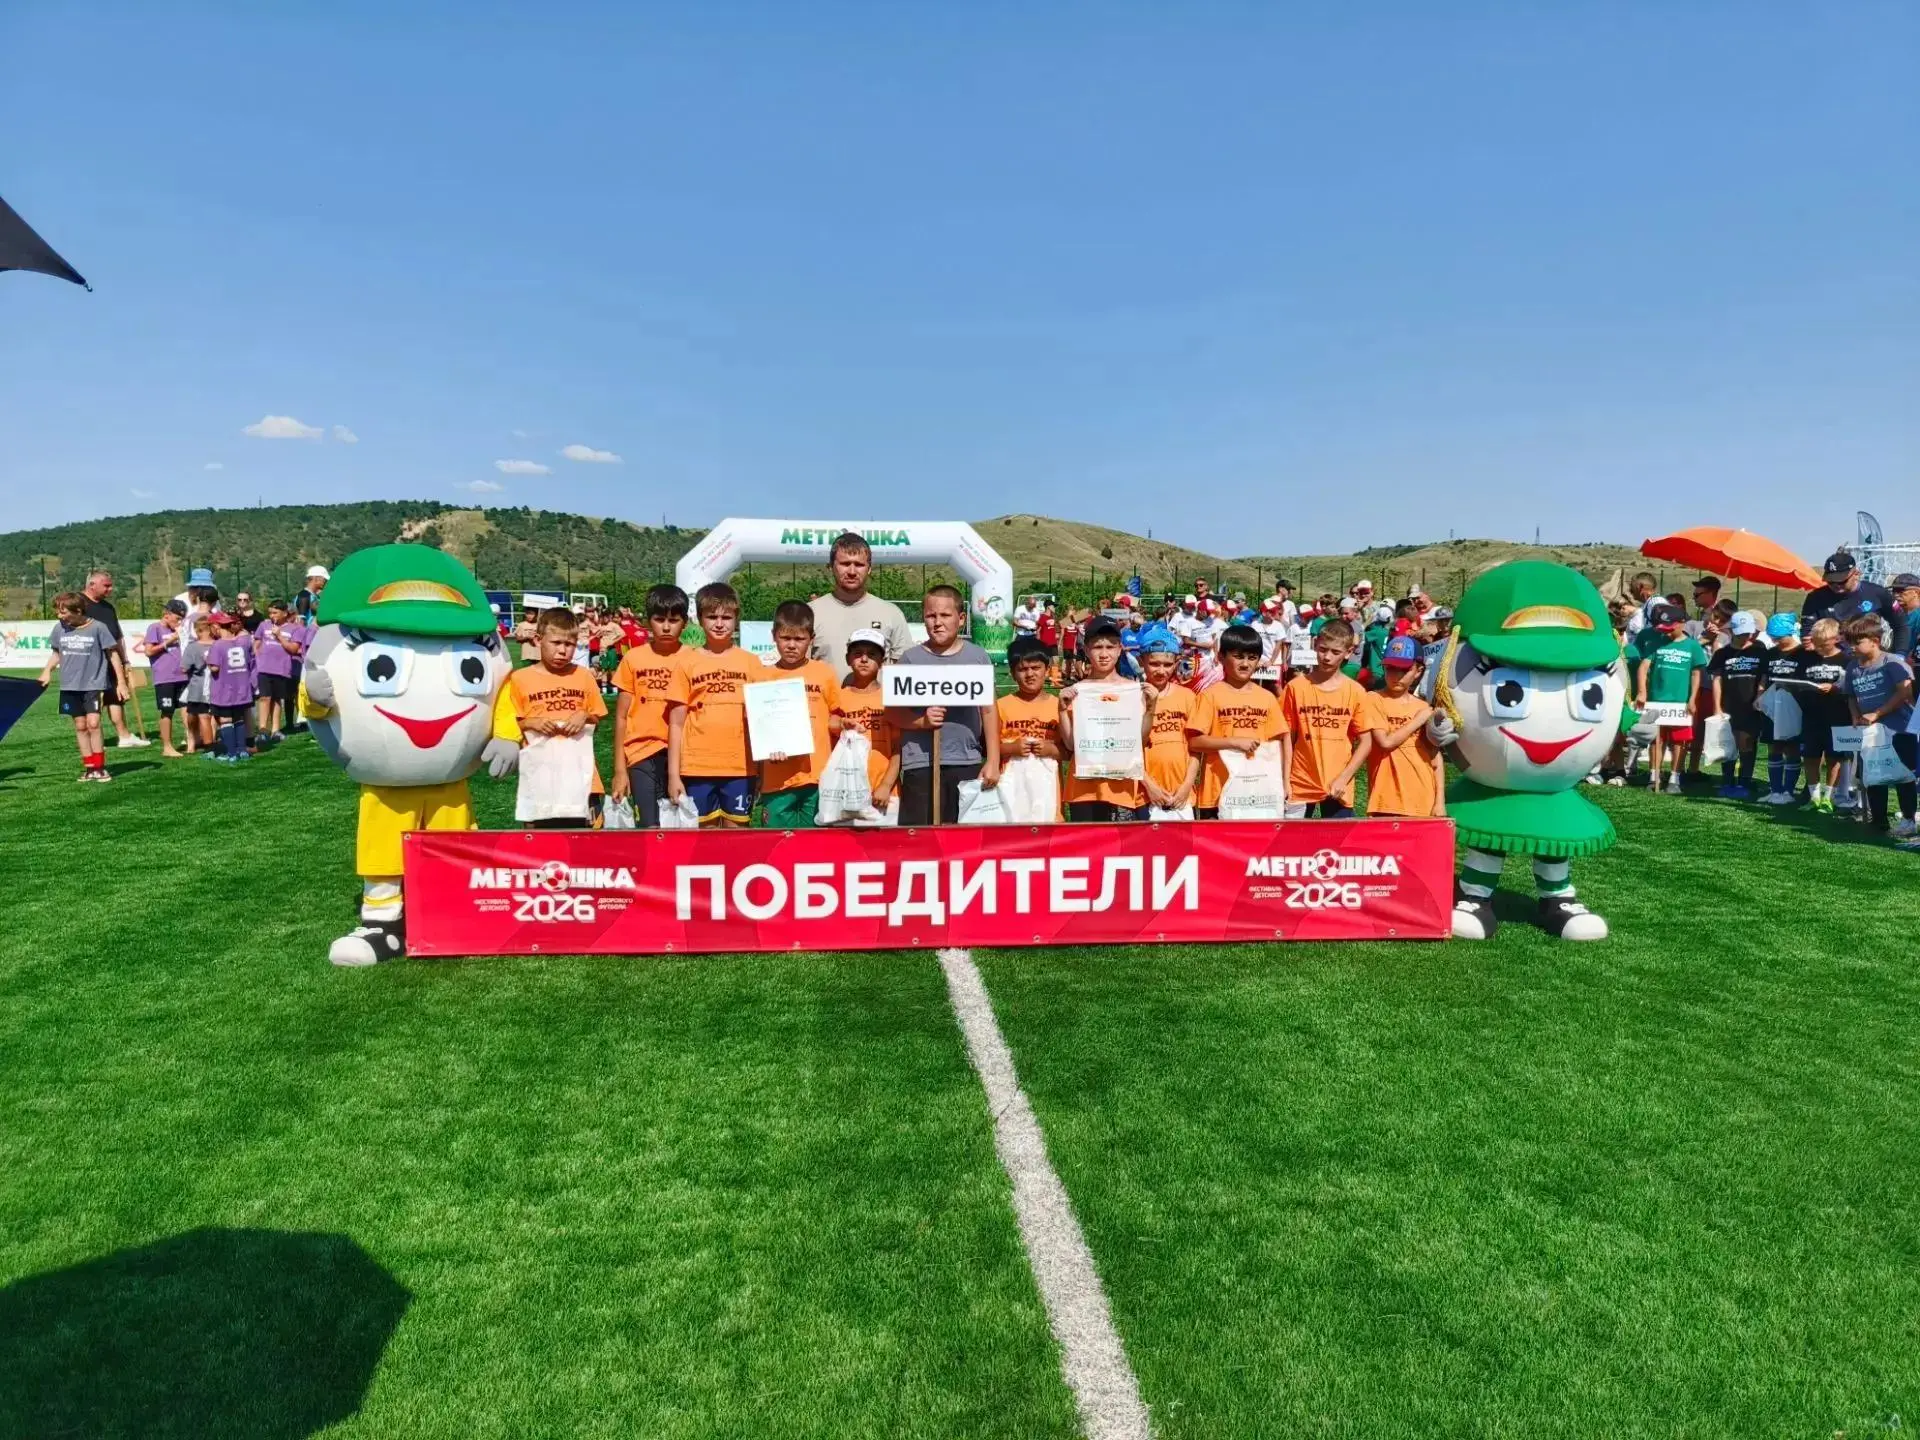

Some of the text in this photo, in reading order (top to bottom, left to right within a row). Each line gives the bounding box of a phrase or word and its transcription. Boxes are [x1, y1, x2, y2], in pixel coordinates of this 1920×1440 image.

[780, 527, 912, 546] МЕТРШКА
[227, 647, 246, 667] 8
[647, 679, 669, 690] 202
[692, 668, 747, 686] МЕТРОШКА
[706, 682, 736, 694] 2026
[893, 676, 984, 700] Метеор
[546, 700, 577, 712] 2026
[1311, 717, 1340, 728] 2026
[1245, 848, 1401, 880] МЕТРОШКА
[468, 860, 637, 892] МЕТРОШКА
[674, 855, 1200, 926] ПОБЕДИТЕЛИ
[1284, 881, 1362, 911] 2026
[512, 893, 597, 924] 2026
